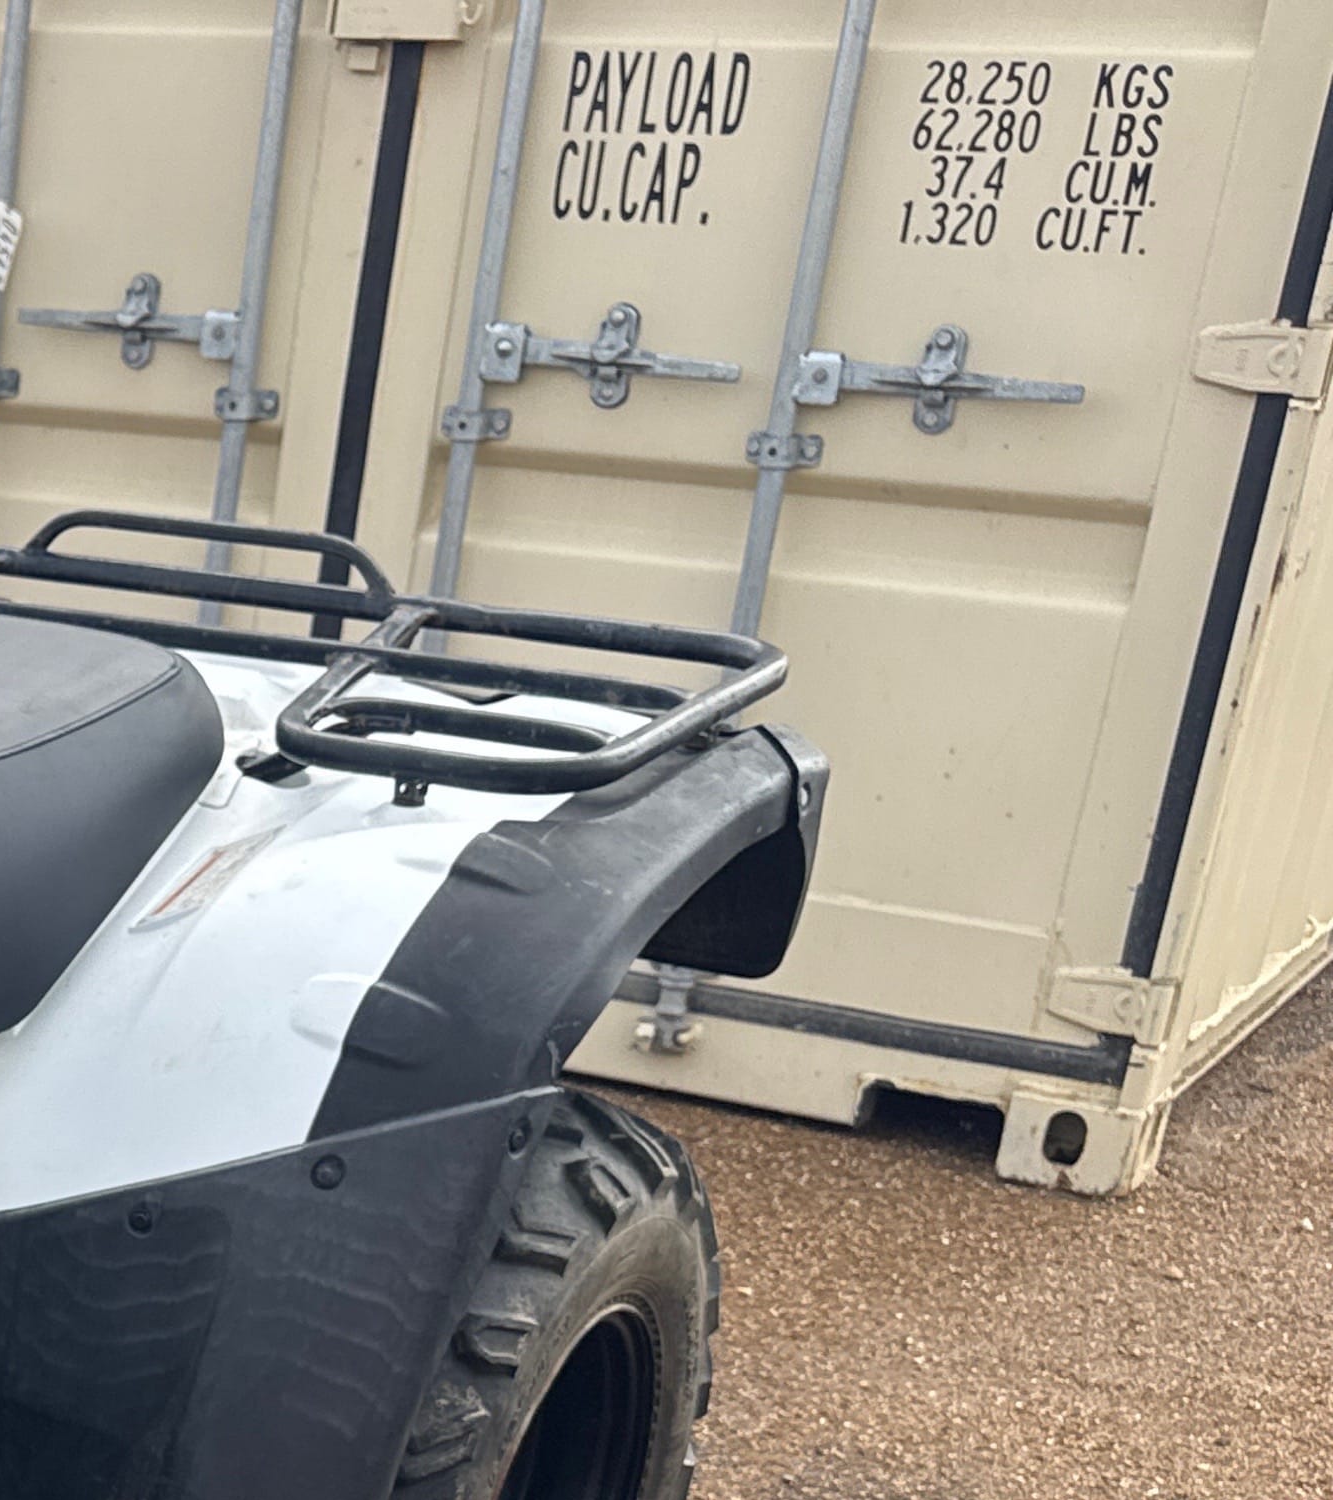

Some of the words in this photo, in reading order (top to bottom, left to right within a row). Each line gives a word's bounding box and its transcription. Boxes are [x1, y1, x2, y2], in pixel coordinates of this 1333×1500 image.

[563, 50, 751, 135] PAYLOAD
[1093, 63, 1174, 109] KGS
[1083, 112, 1163, 158] LBS
[553, 139, 709, 226] CU.CAP.
[925, 155, 1007, 200] 37.4
[1065, 159, 1156, 207] CU.M.
[1036, 207, 1146, 255] CU.FT.
